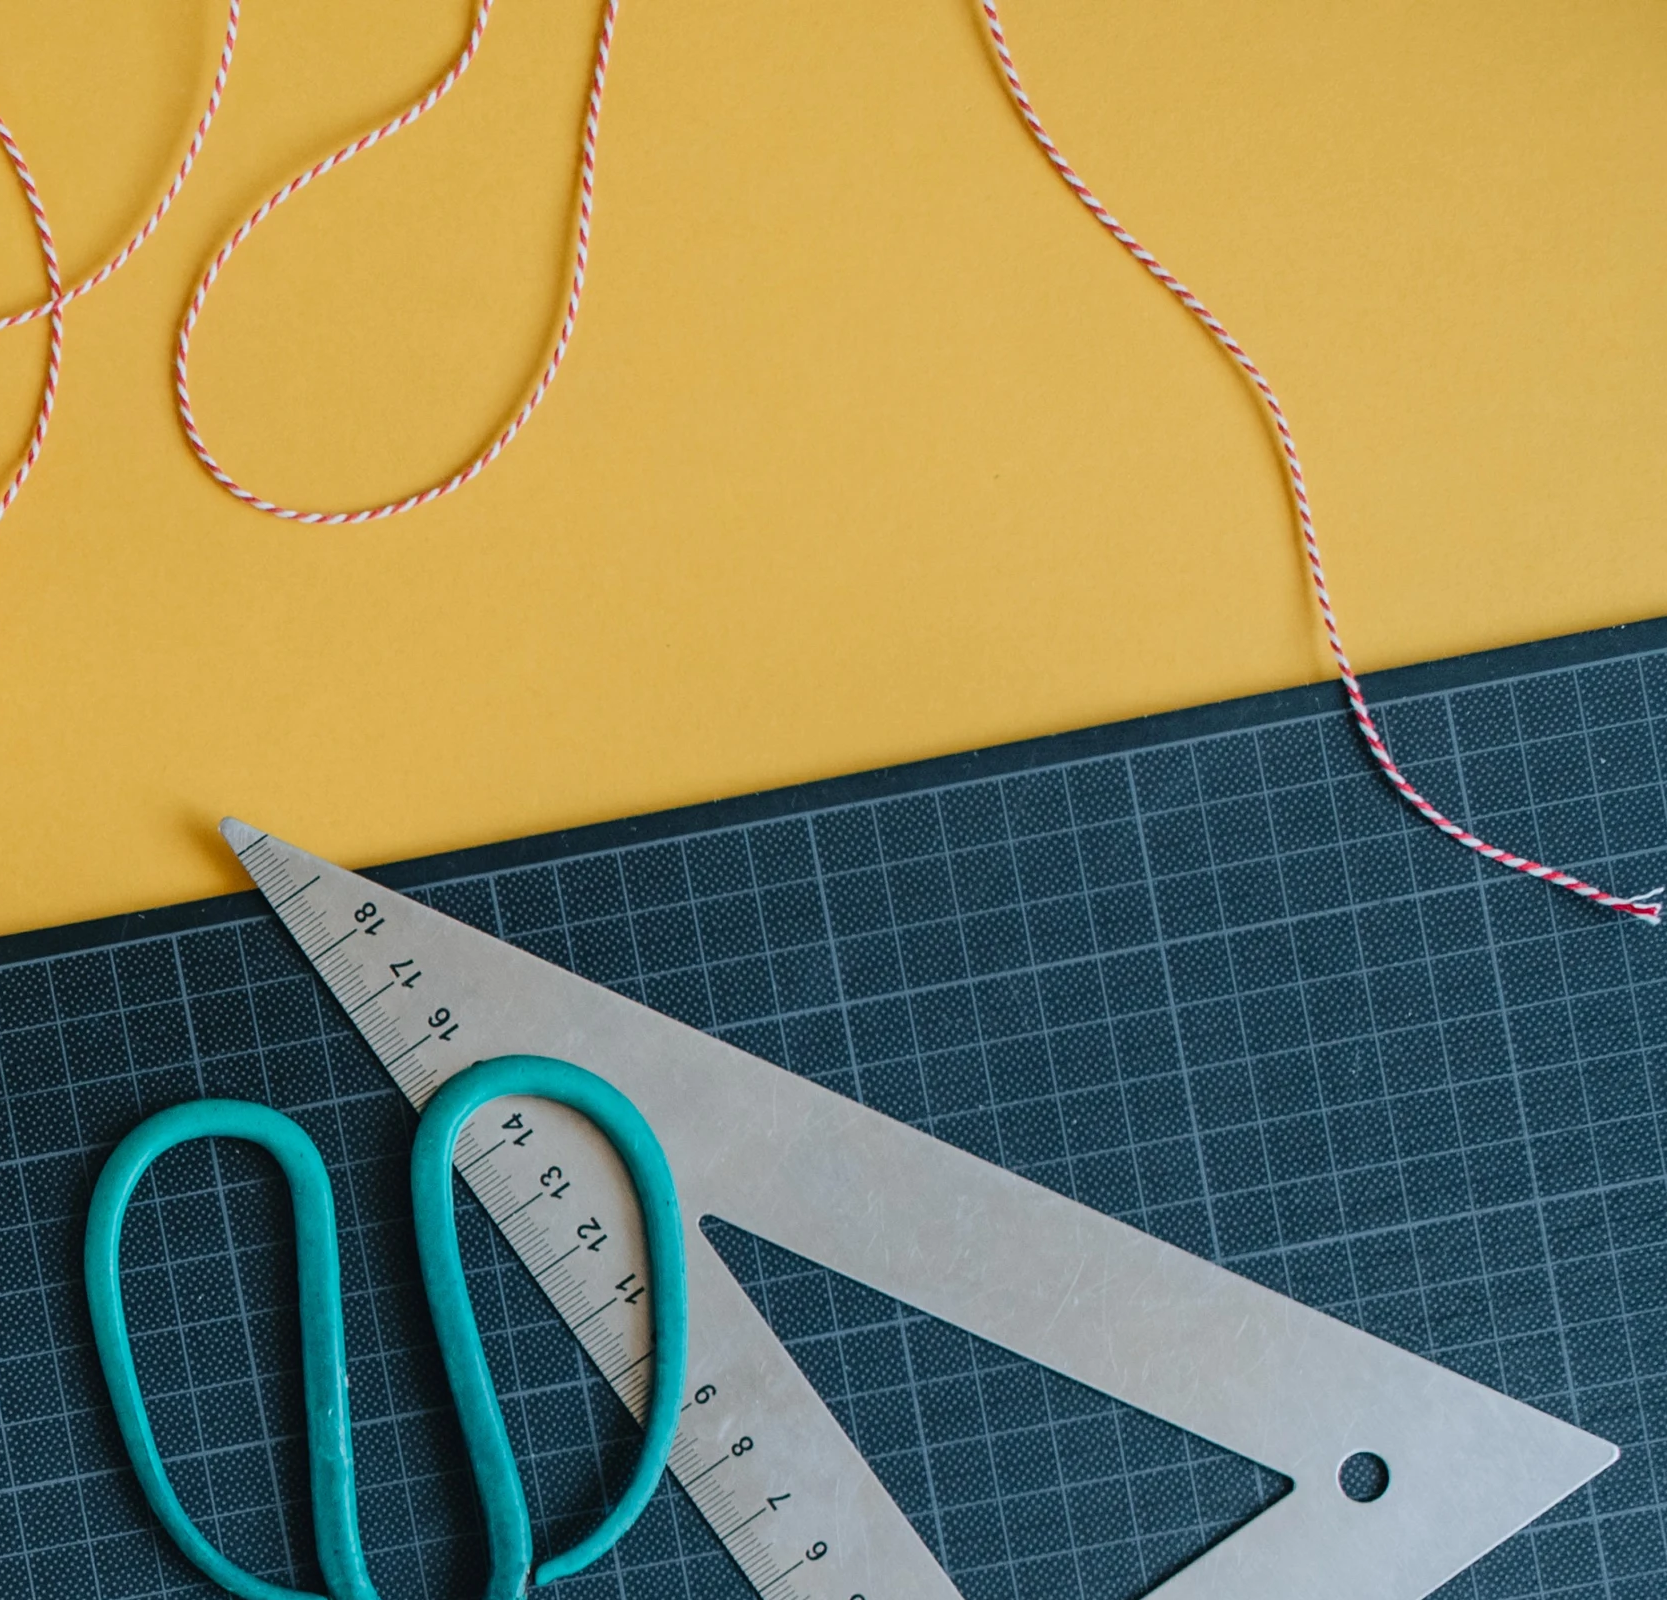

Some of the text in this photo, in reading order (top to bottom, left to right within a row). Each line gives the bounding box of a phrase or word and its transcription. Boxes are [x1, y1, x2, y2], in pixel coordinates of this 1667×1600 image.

[354, 902, 385, 936] 18
[389, 959, 422, 989] 17
[428, 1008, 460, 1041] 16
[501, 1113, 534, 1146] 14
[540, 1166, 571, 1199] 13
[577, 1217, 608, 1252] 12
[615, 1273, 646, 1305] 11
[694, 1384, 717, 1405] 9
[731, 1436, 754, 1457] 8
[766, 1493, 791, 1511] 7
[805, 1541, 828, 1561] 6
